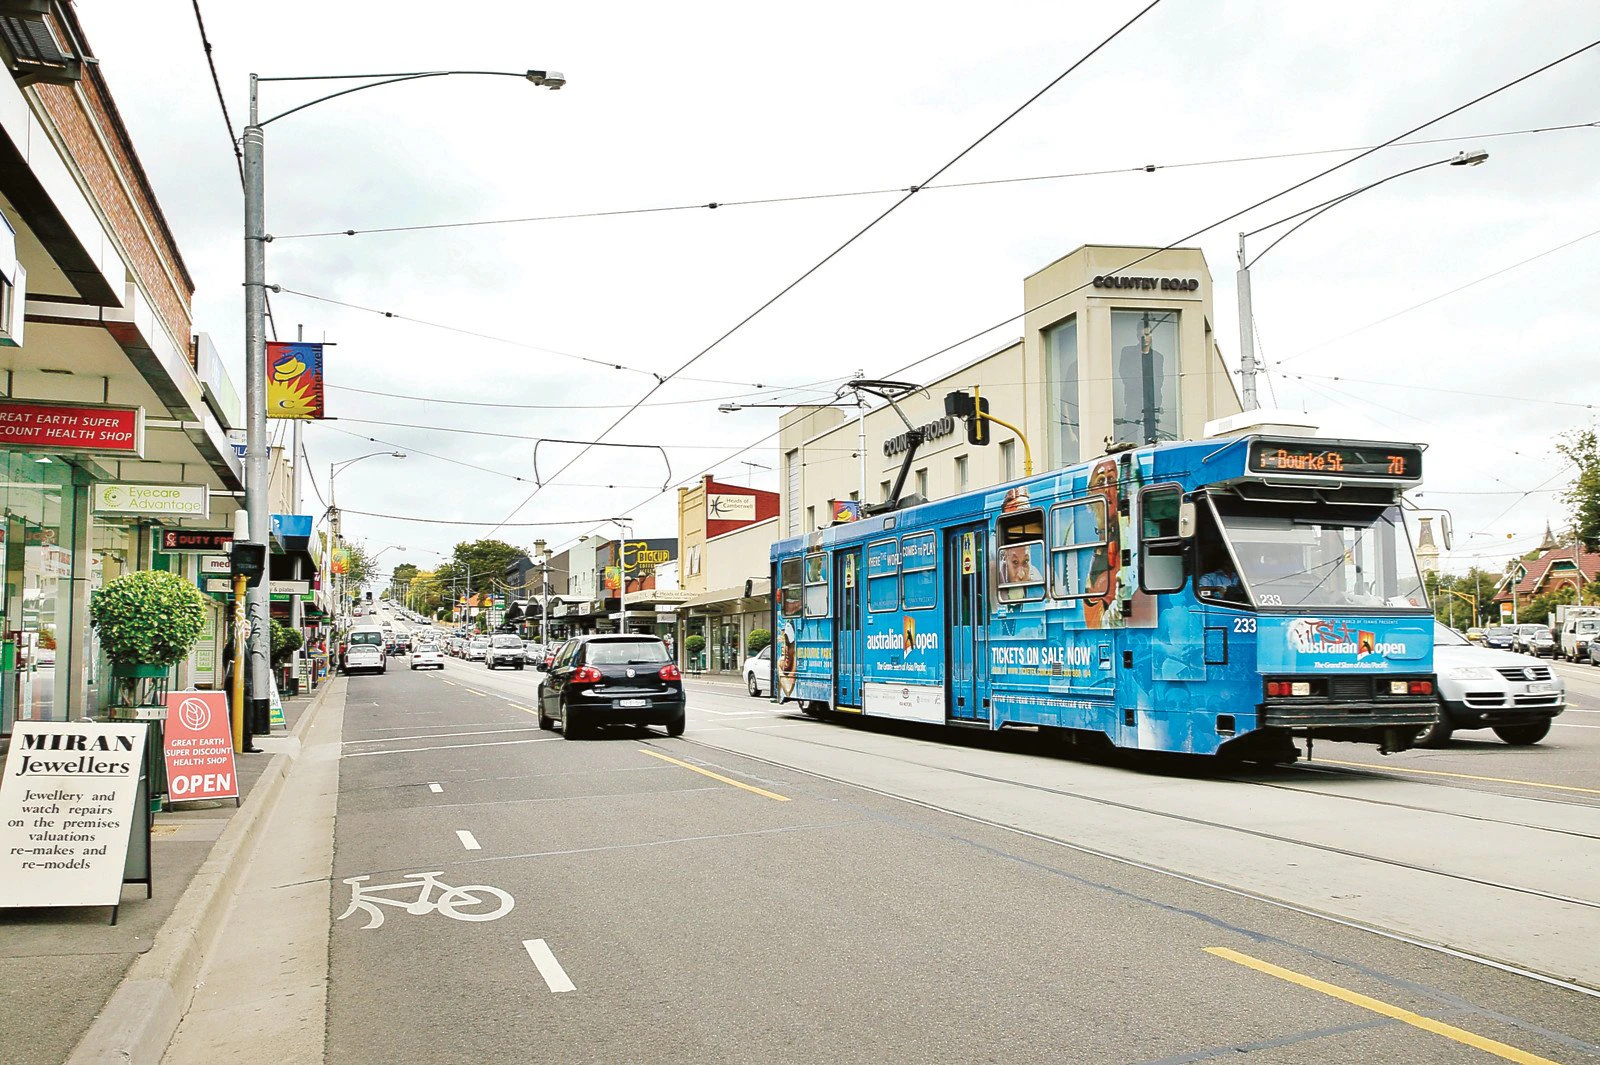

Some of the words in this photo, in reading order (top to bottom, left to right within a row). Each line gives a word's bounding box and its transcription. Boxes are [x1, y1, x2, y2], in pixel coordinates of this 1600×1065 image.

[1093, 275, 1159, 291] COUNTRY
[1161, 278, 1199, 291] ROAD
[36, 414, 78, 425] EARTH
[82, 417, 120, 428] SUPER
[924, 415, 954, 441] ROAD
[46, 428, 95, 439] HEALTH
[99, 431, 133, 441] SHOP
[1278, 449, 1326, 471] Bourke
[1327, 453, 1344, 471] St
[1386, 456, 1405, 475] 70
[129, 486, 180, 498] Eyecare
[128, 498, 201, 512] Advantage
[180, 535, 210, 545] DUTY
[214, 536, 233, 545] FRE
[1259, 594, 1282, 606] 233
[1233, 617, 1257, 633] 233
[868, 628, 904, 650] australian
[915, 632, 939, 655] open
[991, 647, 1024, 664] TICKETS
[1026, 647, 1039, 664] ON
[1041, 647, 1064, 665] SALE
[1067, 647, 1091, 665] NOW
[1374, 642, 1406, 658] open
[20, 733, 136, 752] MIRAN
[171, 739, 197, 747] GREAT
[199, 738, 225, 746] EARTH
[165, 748, 190, 757] SUPER
[192, 747, 232, 756] DISCOUNT
[16, 755, 130, 776] Jewellers
[173, 759, 204, 767] HEALTH
[207, 757, 228, 765] SHOP
[172, 773, 231, 795] OPEN
[23, 789, 84, 803] Jewellery
[92, 790, 115, 802] and
[22, 803, 60, 814] watch
[69, 804, 113, 817] repairs
[7, 819, 25, 828] on
[33, 817, 55, 828] the
[63, 818, 120, 831] premises
[28, 830, 96, 842] valuations
[83, 845, 107, 856] and
